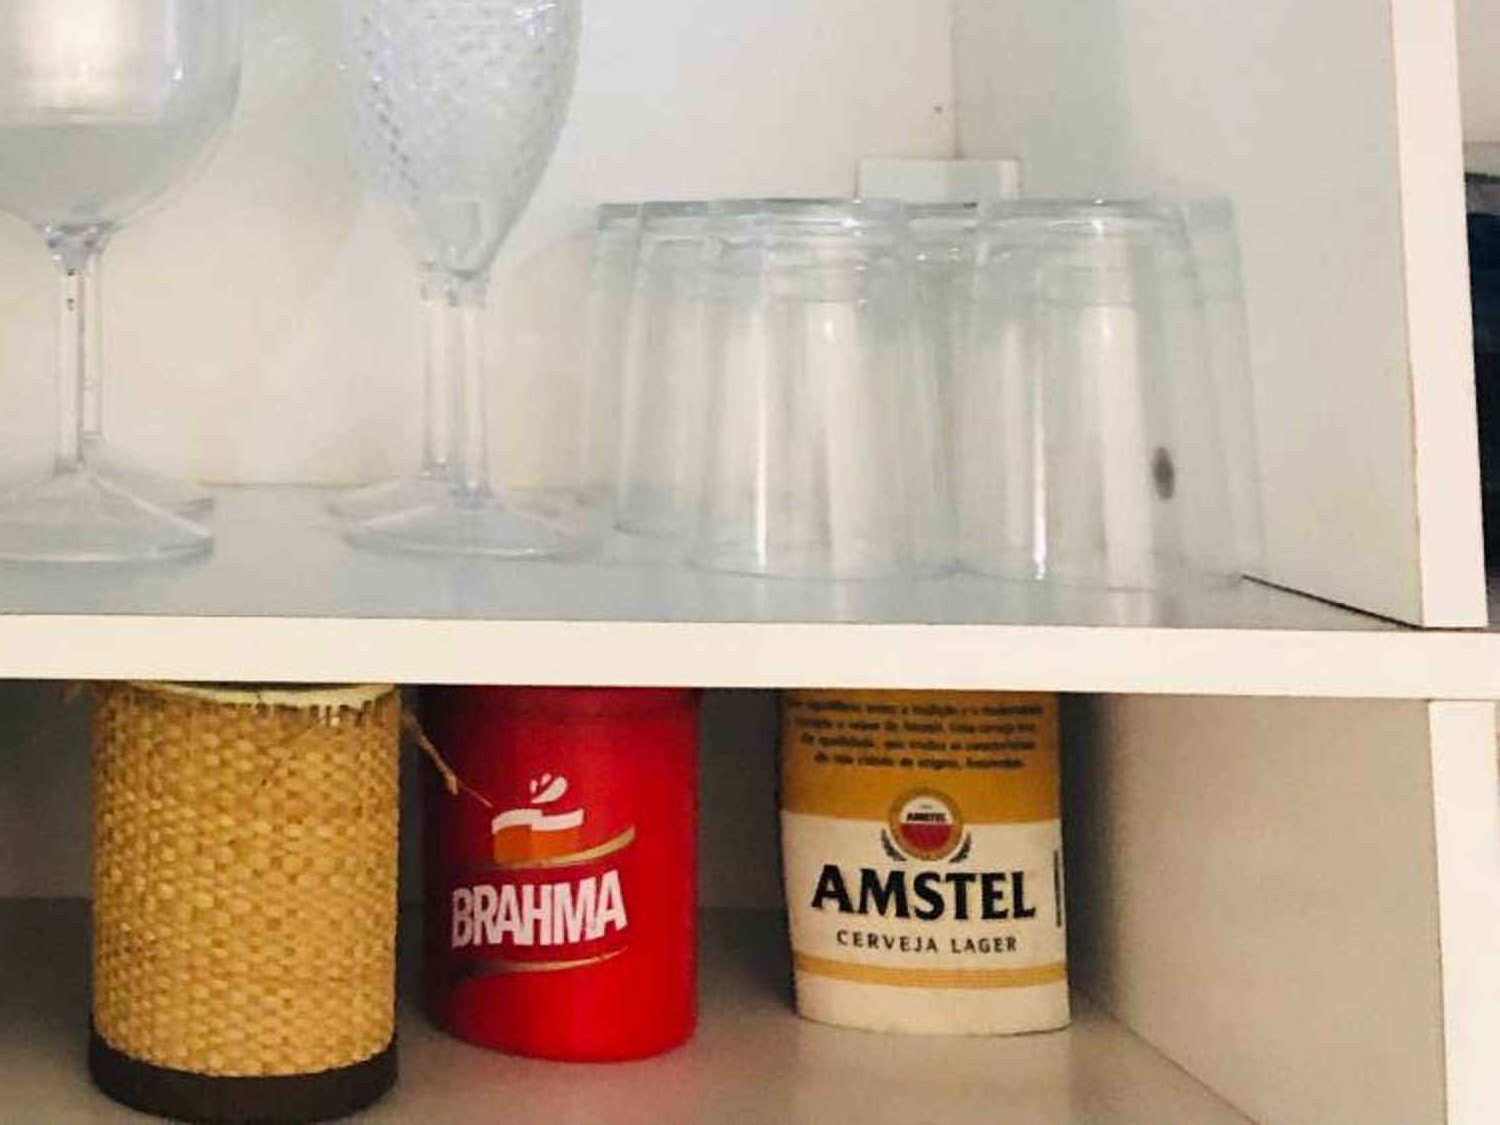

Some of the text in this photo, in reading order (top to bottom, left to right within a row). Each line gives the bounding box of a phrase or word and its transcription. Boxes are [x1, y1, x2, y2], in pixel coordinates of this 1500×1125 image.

[451, 869, 628, 949] BRAHMA
[811, 864, 1037, 921] AMSTEL
[836, 929, 1019, 955] CERVEJA LAGER
